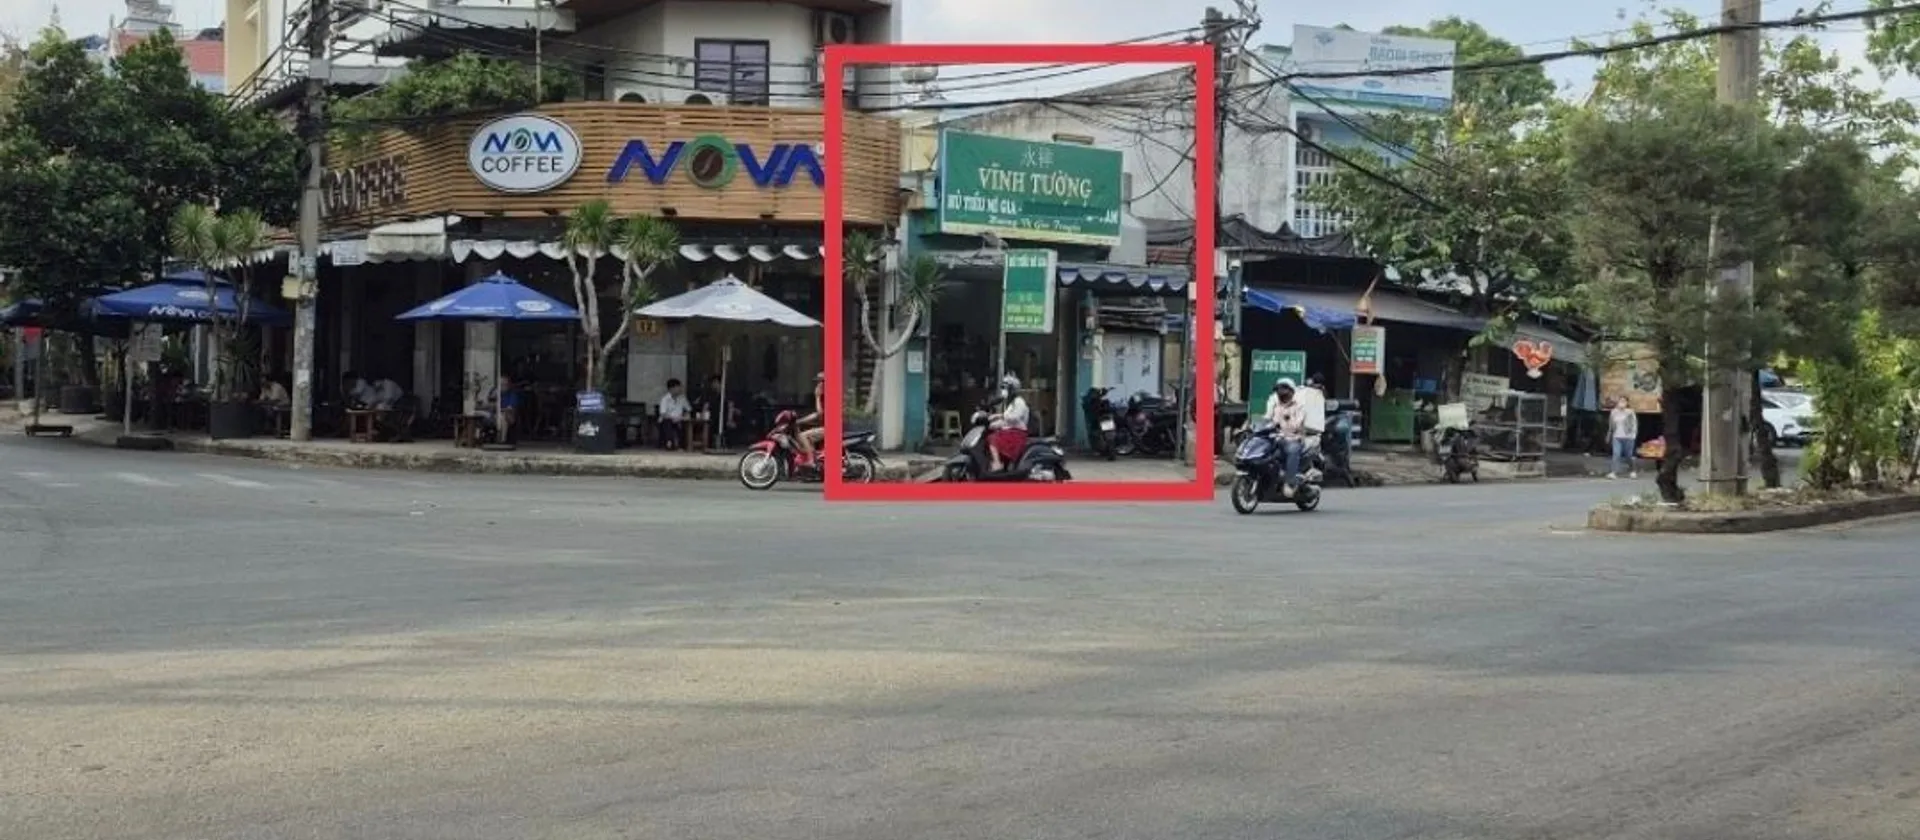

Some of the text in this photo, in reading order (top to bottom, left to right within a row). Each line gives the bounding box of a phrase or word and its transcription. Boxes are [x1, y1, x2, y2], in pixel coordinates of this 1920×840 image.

[482, 128, 563, 153] NOVA
[481, 155, 564, 173] COFFEE
[607, 132, 825, 189] NOVA
[978, 163, 1026, 193] VĨNH
